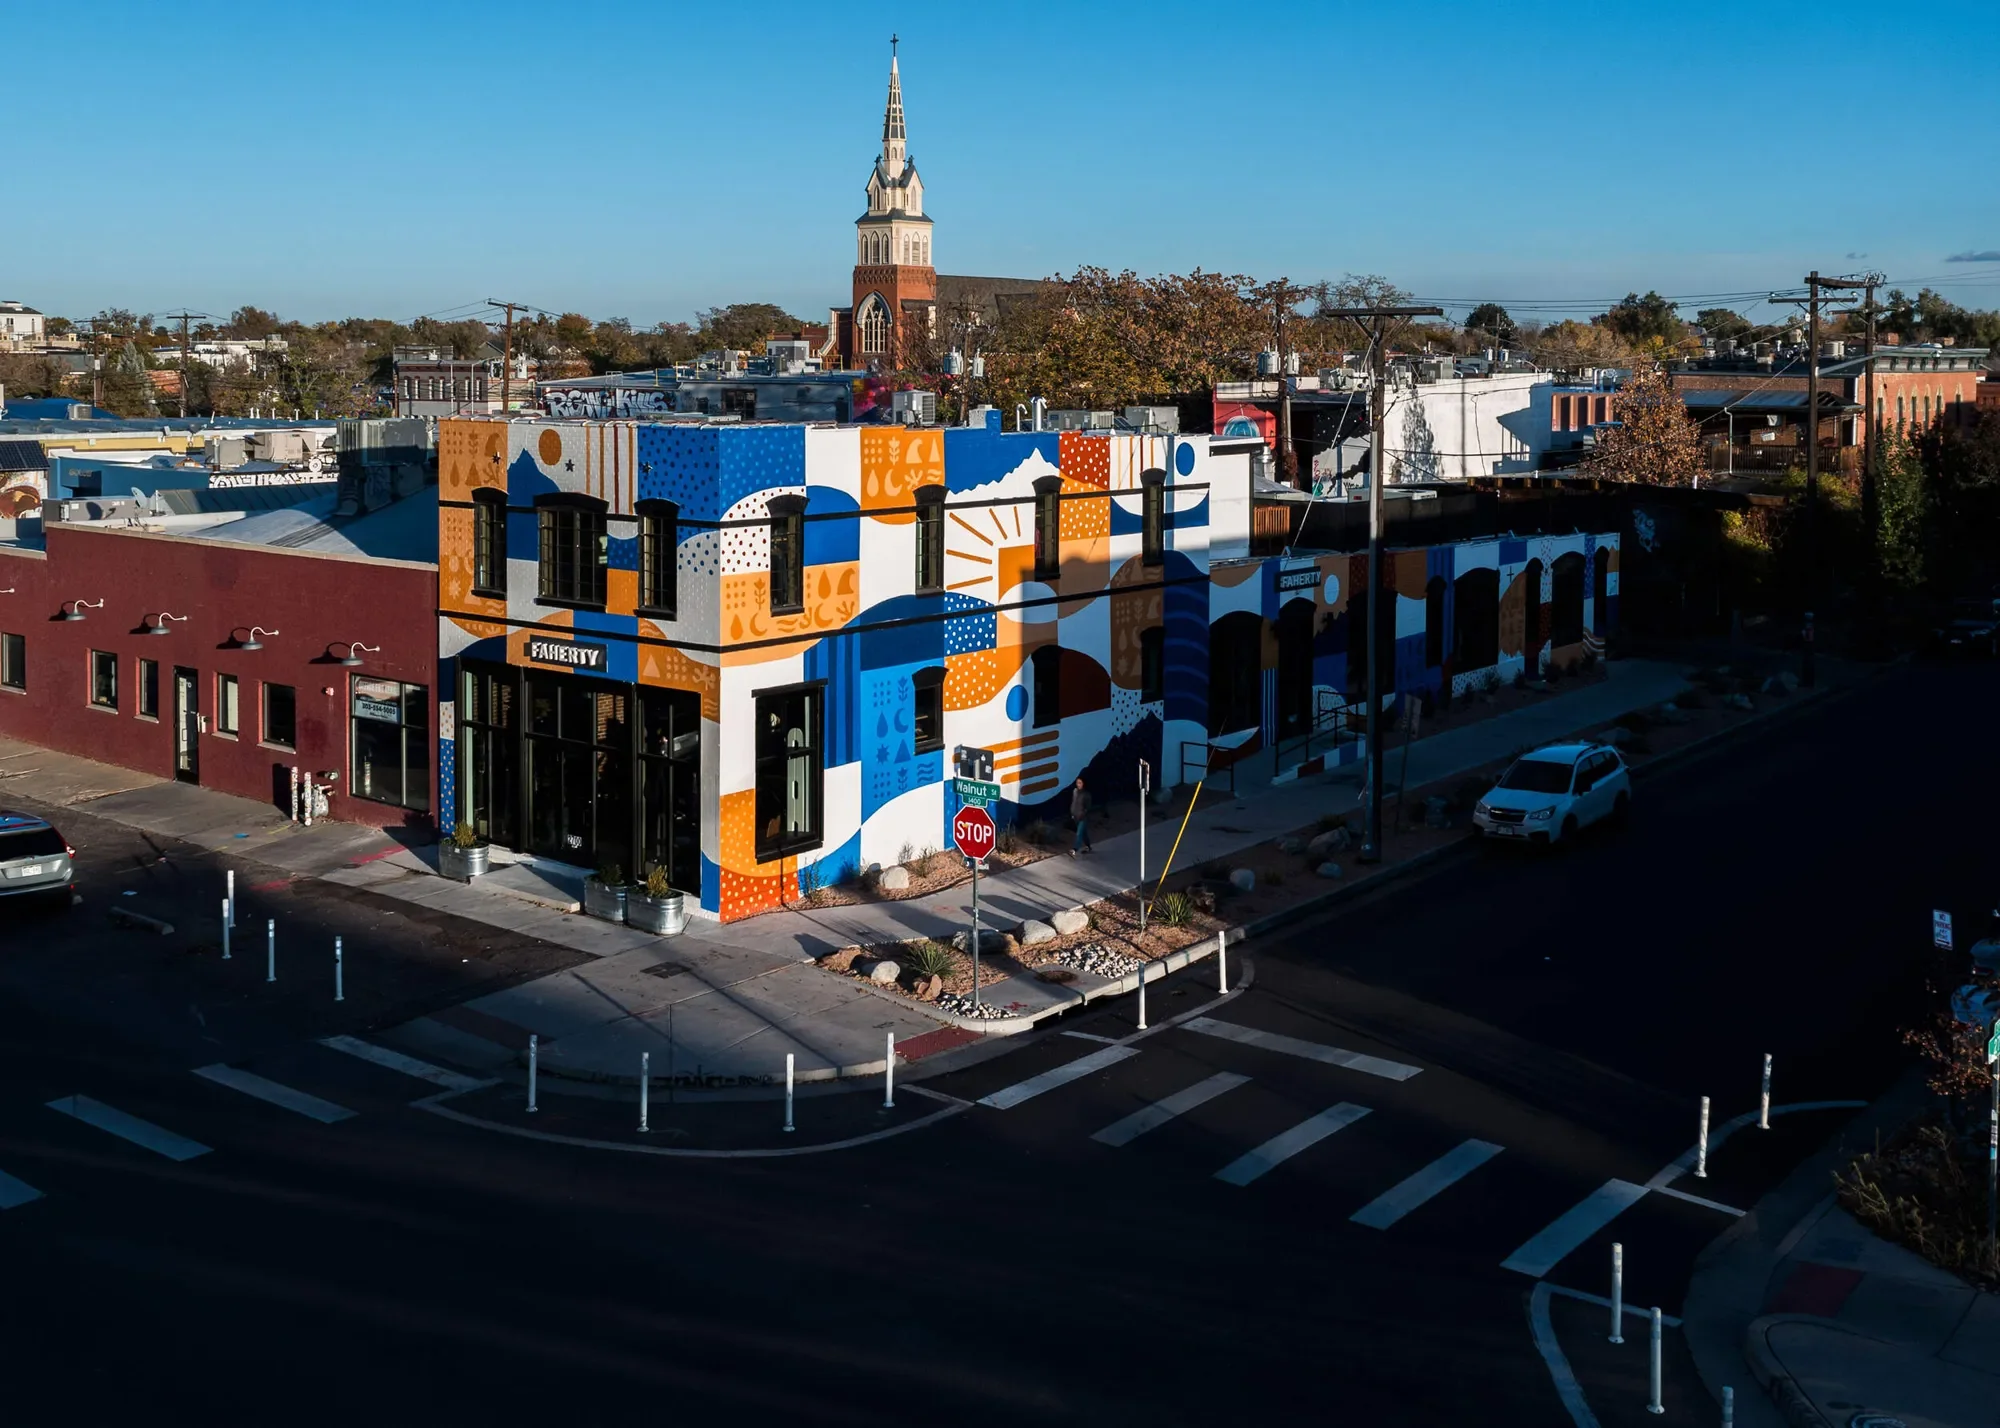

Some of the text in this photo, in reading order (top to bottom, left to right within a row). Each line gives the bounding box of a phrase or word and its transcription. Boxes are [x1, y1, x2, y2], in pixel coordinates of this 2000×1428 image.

[1280, 571, 1321, 588] FAHERTY
[531, 642, 599, 666] FAHERTY
[956, 781, 987, 797] Walnut
[956, 820, 992, 844] STOP
